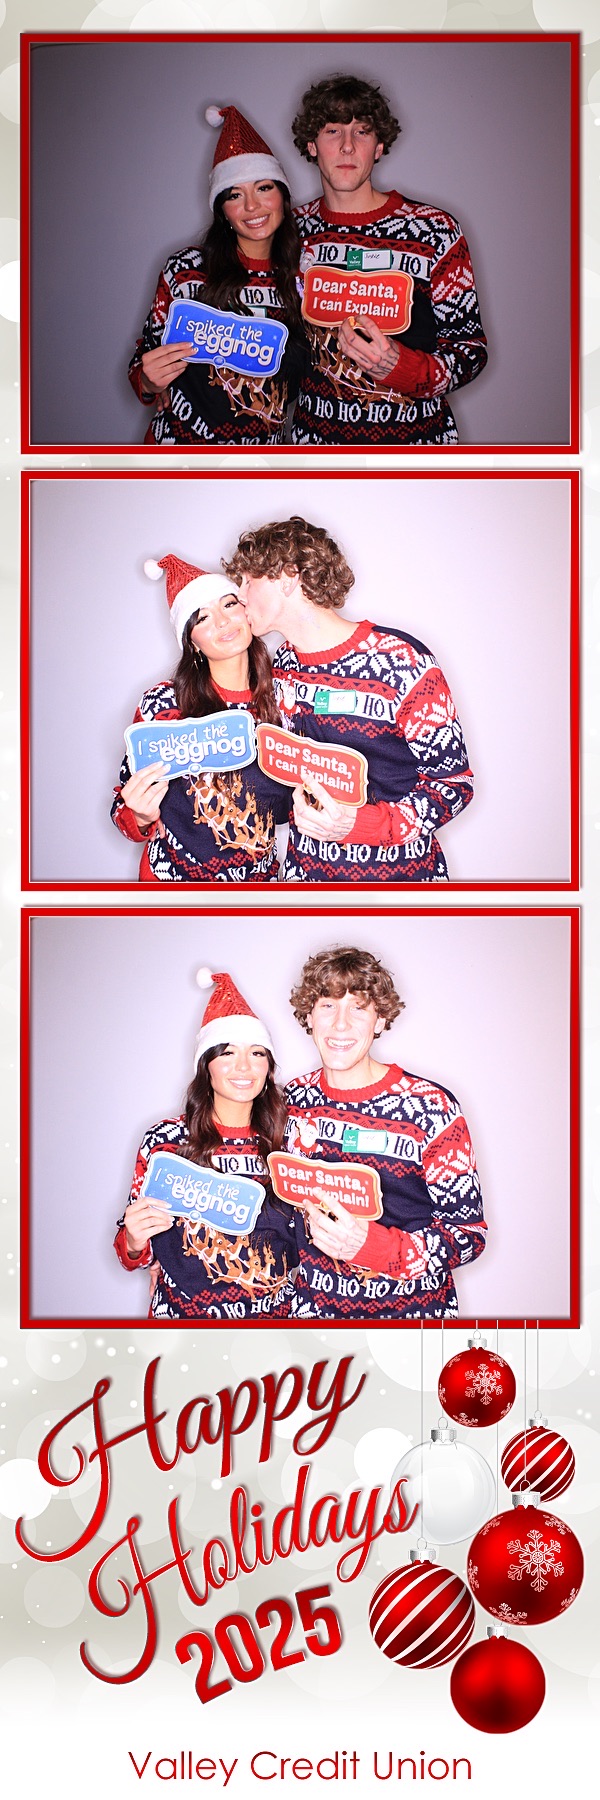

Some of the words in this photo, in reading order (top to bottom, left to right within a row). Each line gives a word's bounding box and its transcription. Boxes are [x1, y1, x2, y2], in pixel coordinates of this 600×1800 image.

[317, 244, 338, 262] HO
[399, 253, 421, 275] HO
[244, 287, 264, 304] HO
[312, 277, 347, 294] Dear
[349, 280, 398, 302] Santa,
[313, 296, 318, 309] I
[320, 299, 342, 312] can
[345, 300, 399, 318] Explain!
[175, 315, 182, 330] I
[186, 319, 235, 338] spiked
[239, 325, 263, 342] the
[194, 331, 274, 366] eggnog
[314, 396, 333, 419] HO
[338, 401, 361, 422] HO
[366, 402, 392, 423] HO
[362, 694, 384, 718] HO
[138, 740, 142, 755] I
[149, 728, 197, 753] spiked
[203, 724, 229, 739] the
[160, 736, 246, 765] eggnog
[265, 736, 300, 758] Dear
[302, 748, 352, 779] Santa,
[268, 754, 274, 765] I
[275, 758, 298, 774] can
[319, 840, 340, 862] HO
[345, 843, 371, 863] HO
[405, 839, 425, 860] HO
[394, 1136, 414, 1157] HO
[217, 1157, 239, 1173] HO
[155, 1168, 162, 1181] I
[164, 1173, 213, 1194] spiked
[217, 1183, 240, 1200] the
[277, 1163, 313, 1181] Dear
[315, 1170, 366, 1195] Santa,
[171, 1184, 250, 1224] eggnog
[283, 1180, 289, 1191] I
[290, 1183, 312, 1196] can
[315, 1187, 370, 1208] plain!
[310, 1269, 333, 1293] HO
[336, 1276, 360, 1297] HO
[364, 1279, 390, 1300] HO
